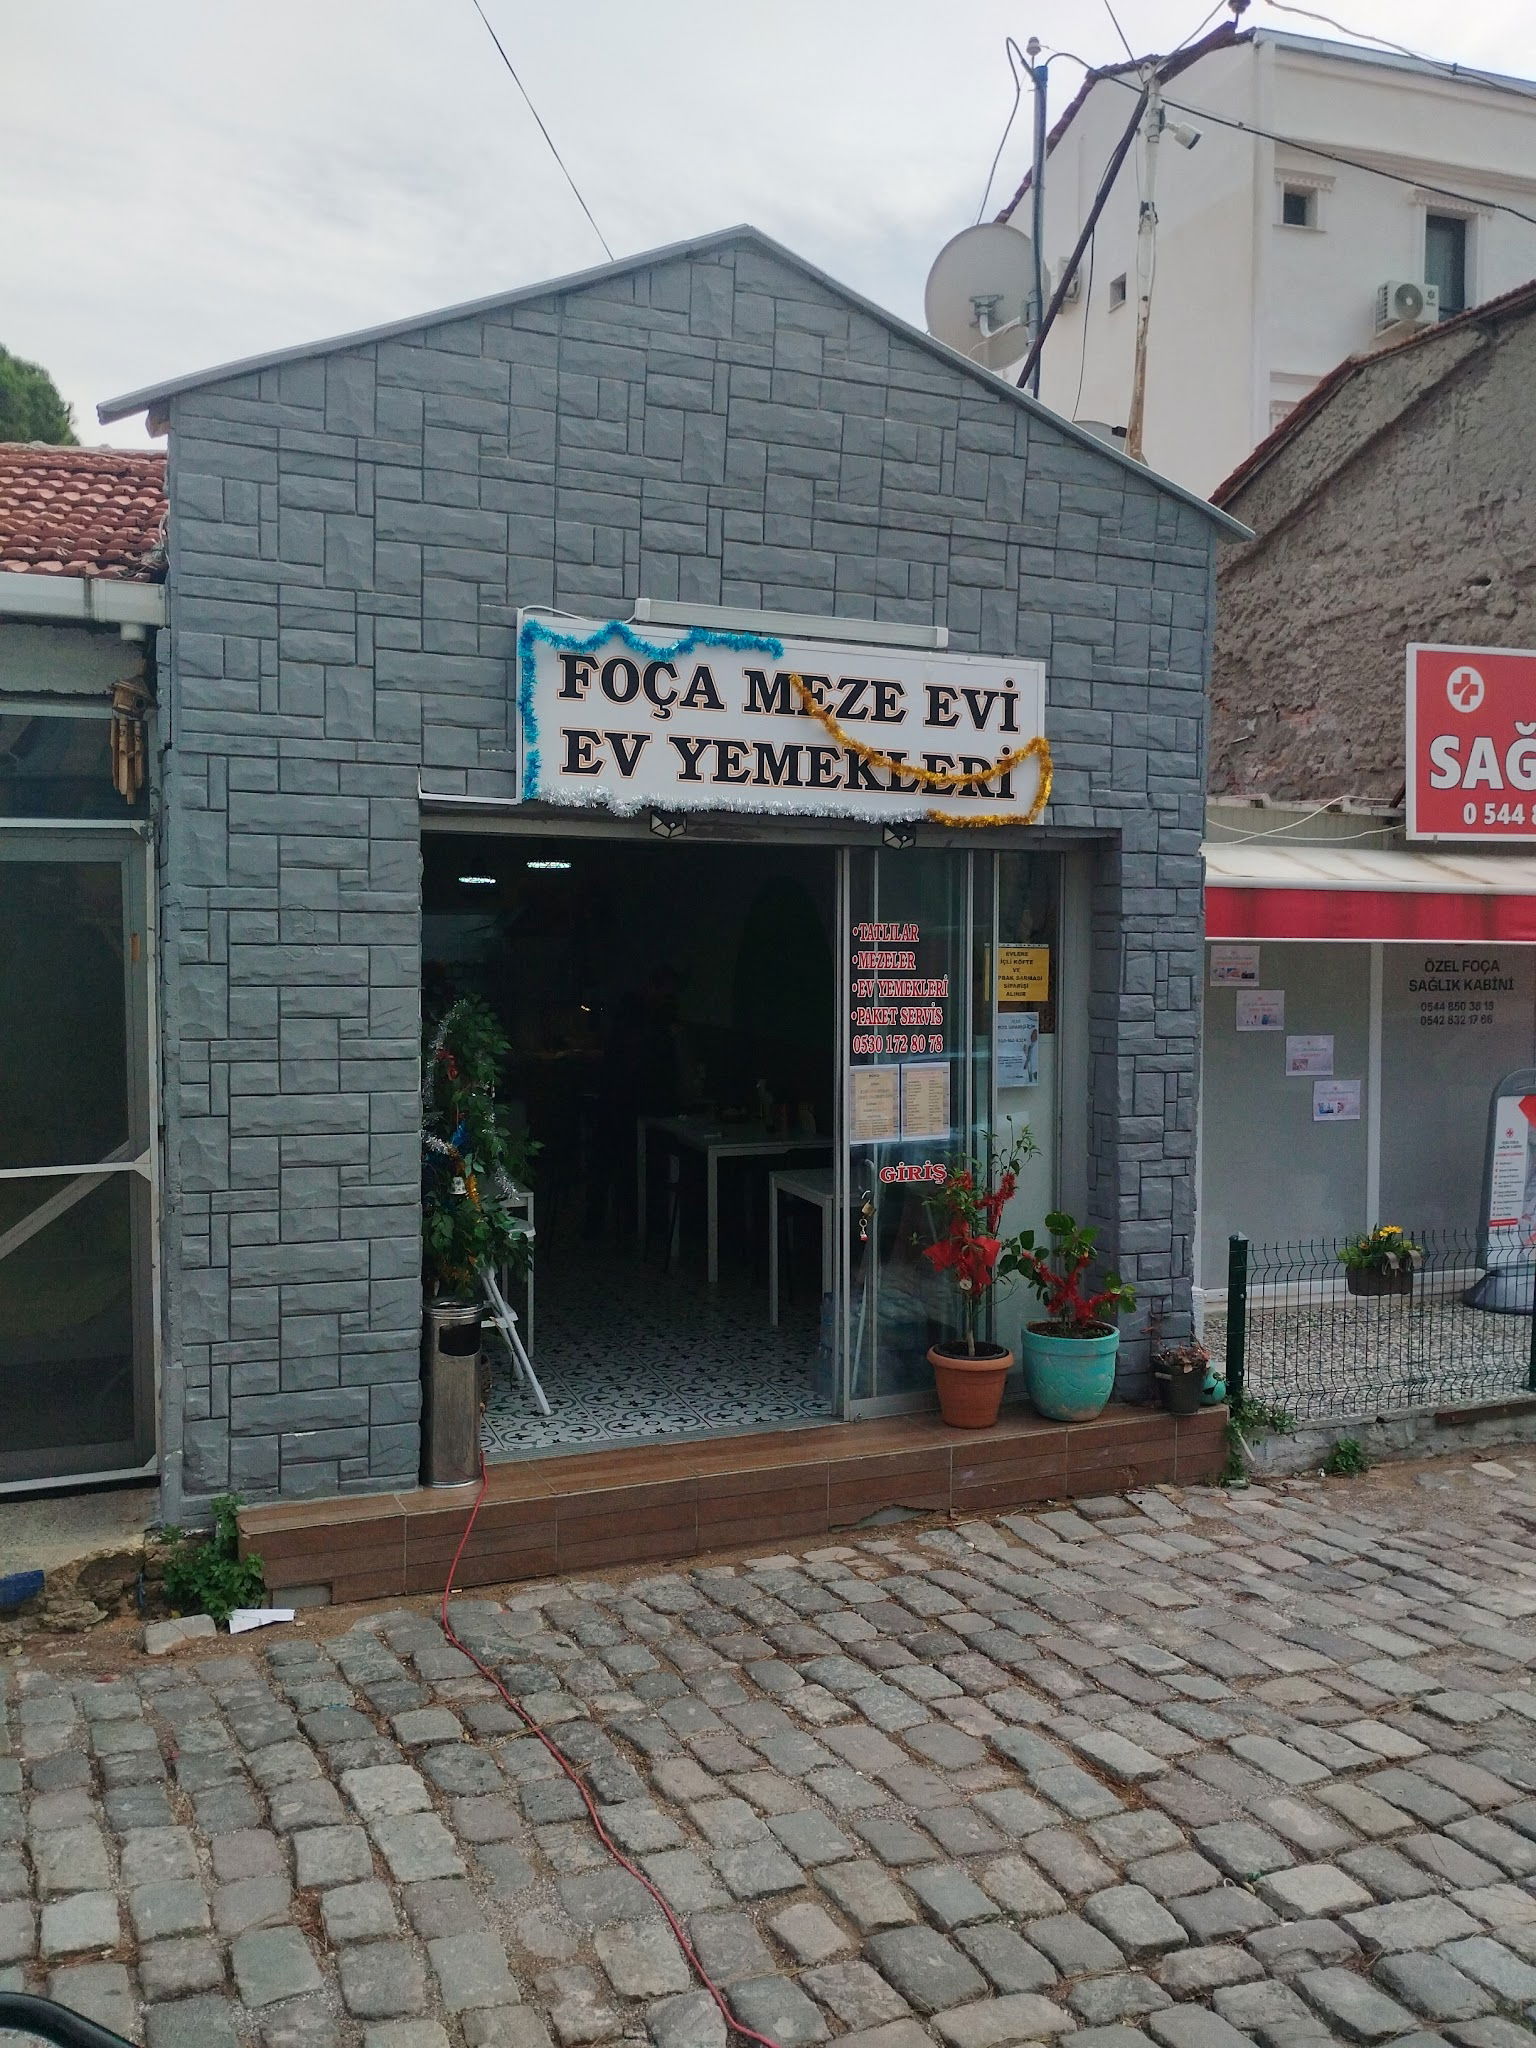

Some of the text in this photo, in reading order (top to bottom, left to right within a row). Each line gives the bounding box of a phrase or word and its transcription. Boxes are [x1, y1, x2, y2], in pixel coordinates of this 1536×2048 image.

[557, 652, 1020, 734] FOÇA MEZE EVİ
[560, 728, 1017, 801] EV YEMEKLERİ
[1463, 803, 1477, 826] 0
[1484, 803, 1526, 826] 544
[858, 923, 919, 942] TATLILAR
[857, 951, 917, 970] MEZELER
[1424, 957, 1500, 975] ÖZEL FOÇA
[857, 974, 949, 998] EV YEMEKLERİ
[1409, 975, 1515, 992] SAĞLIK KABİNİ
[857, 1002, 944, 1026] PAKET SERVİS
[853, 1034, 943, 1054] 0530 172 80 78
[880, 1160, 948, 1186] GİRİŞ
